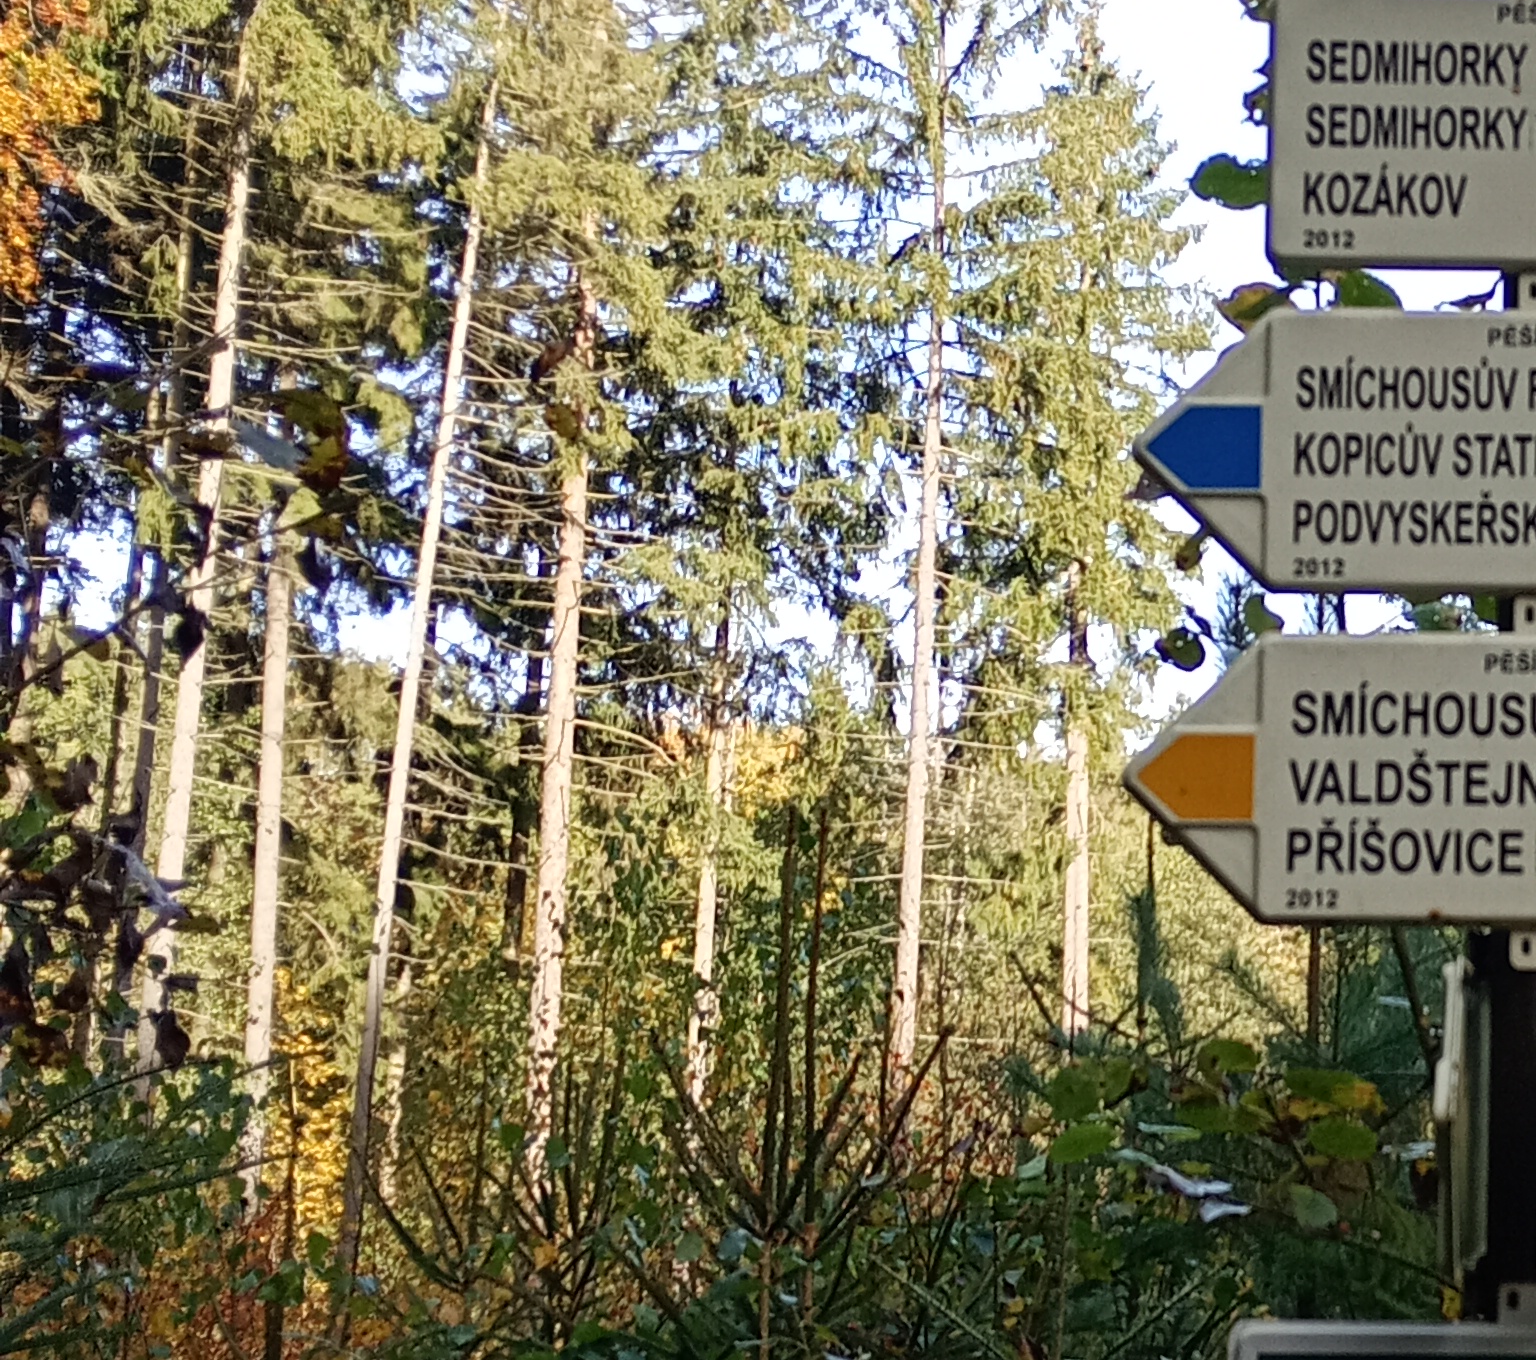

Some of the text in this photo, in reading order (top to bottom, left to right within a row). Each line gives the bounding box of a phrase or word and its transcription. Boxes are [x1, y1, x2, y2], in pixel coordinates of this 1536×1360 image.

[1306, 39, 1528, 86] SEDMIHORKY
[1305, 104, 1528, 150] SEDMIHORKY
[1303, 164, 1468, 218] KOZÁKOV
[1303, 230, 1355, 249] 2012
[1296, 356, 1519, 412] SMÍCHOUSŮV
[1293, 422, 1443, 478] KOPICŮV
[1293, 557, 1345, 578] 2012
[1285, 820, 1524, 875] PŘÍŠOVICE
[1286, 888, 1339, 910] 2012
